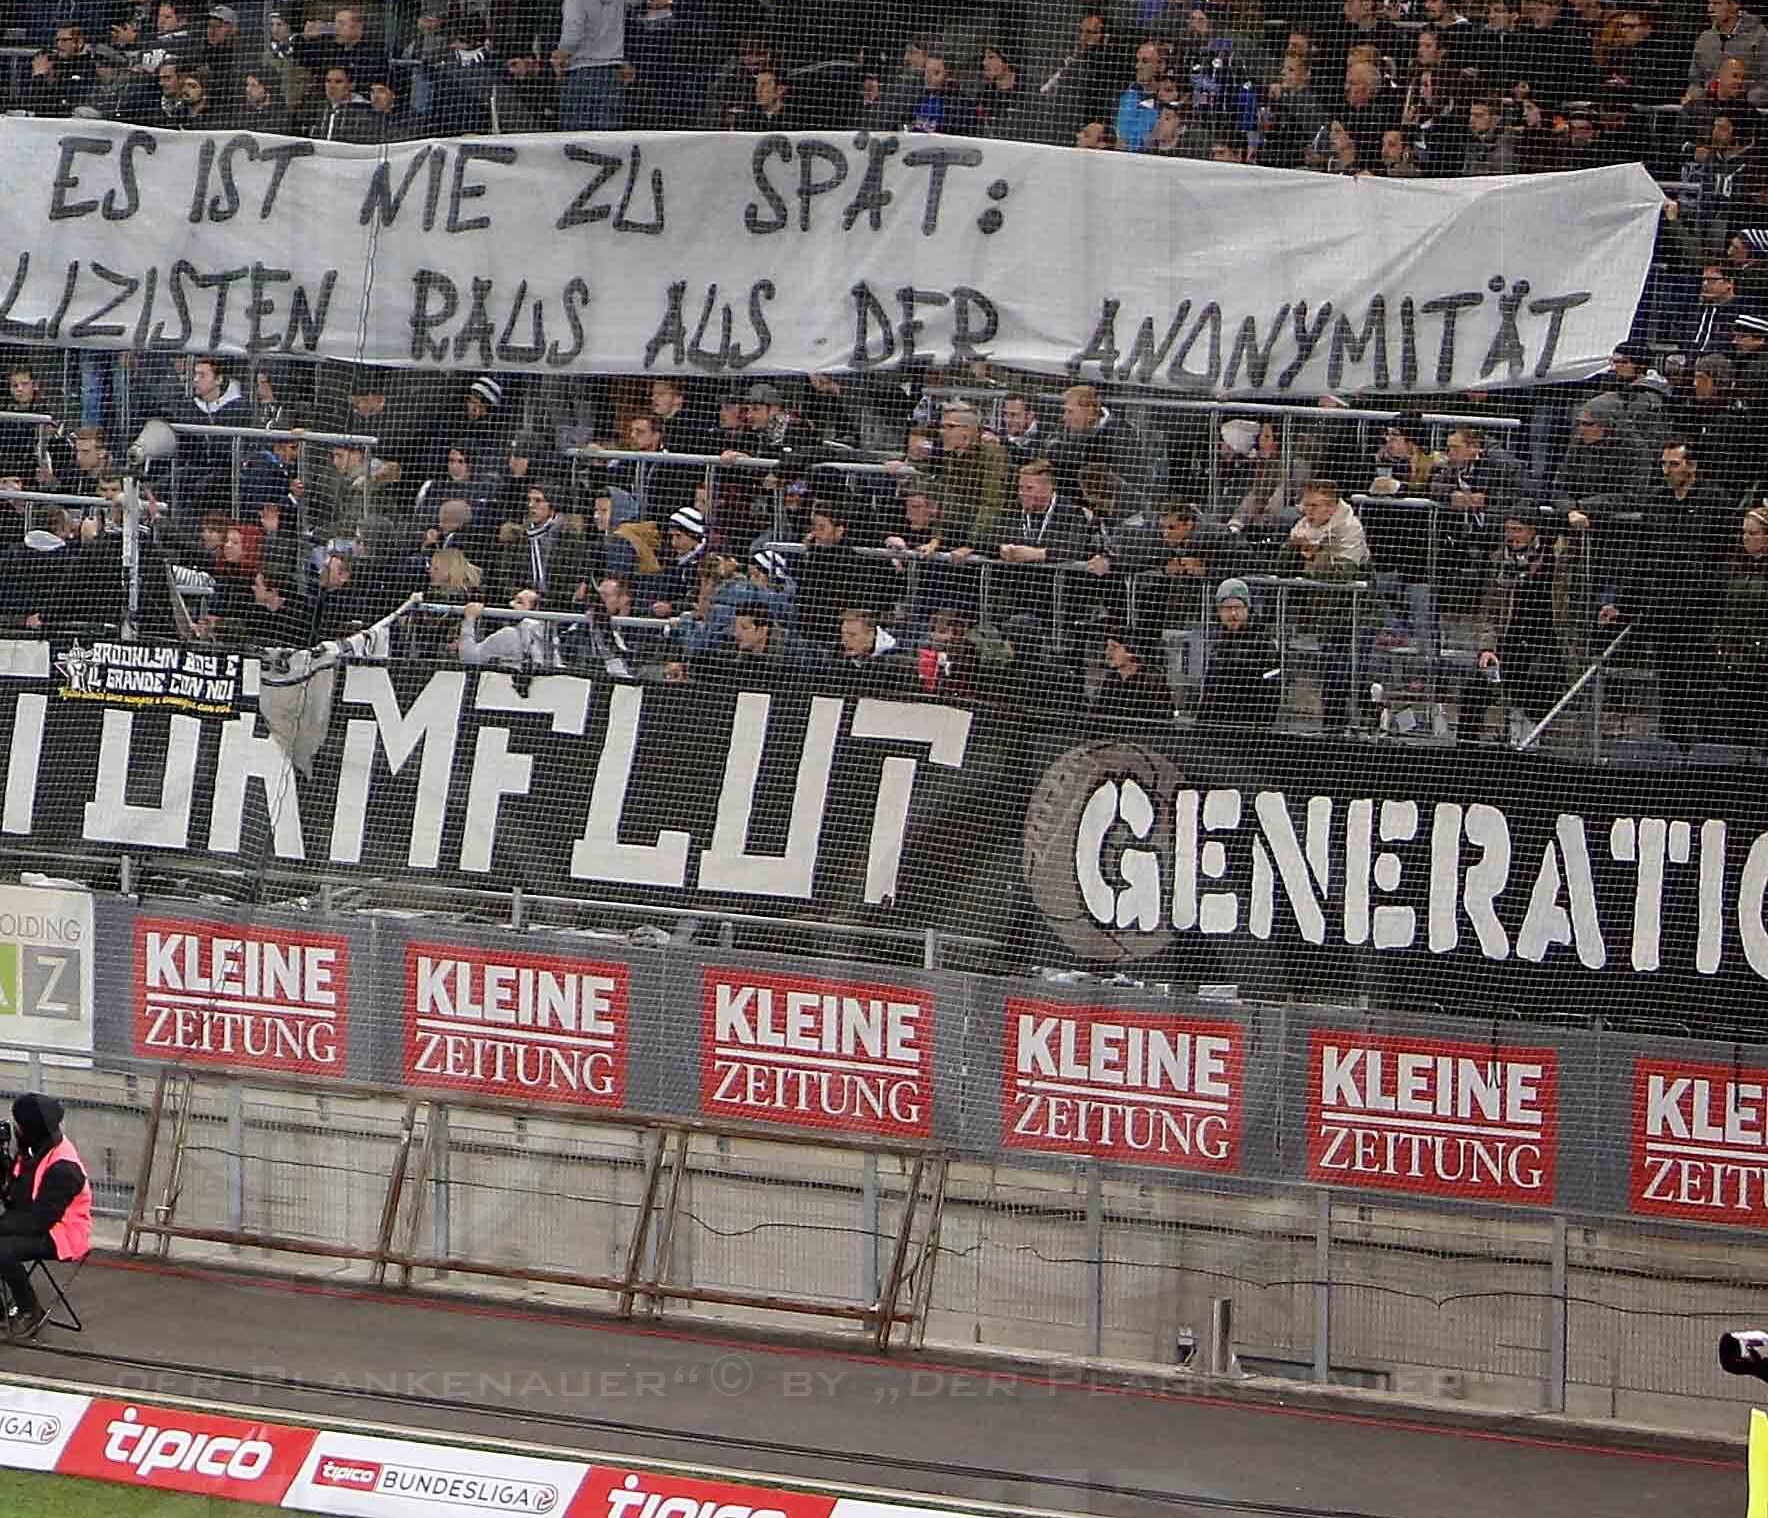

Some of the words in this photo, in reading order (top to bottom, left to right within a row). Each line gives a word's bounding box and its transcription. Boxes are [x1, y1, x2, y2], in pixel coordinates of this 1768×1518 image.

[50, 129, 155, 223] ES
[190, 134, 315, 225] IST
[361, 144, 516, 233] NIE
[557, 142, 665, 238] ZU
[744, 129, 1010, 236] SPÄT:
[409, 267, 590, 370] RAUS
[644, 279, 776, 373] AUS
[849, 283, 1000, 368] DER
[1067, 275, 1593, 396] ANONYMITÄT
[144, 932, 337, 1005] KLEINE
[416, 955, 617, 1036] KLEINE
[143, 1005, 338, 1063] ZEITUNG
[713, 984, 923, 1064] KLEINE
[1016, 1015, 1231, 1098] KLEINE
[414, 1031, 617, 1096] ZEITUNG
[712, 1060, 922, 1125] ZEITUNG
[1320, 1044, 1543, 1126] KLEINE
[1013, 1091, 1231, 1161] ZEITUNG
[1646, 1074, 1768, 1146] KLE
[1318, 1125, 1544, 1190] ZEITUNG
[1642, 1155, 1768, 1211] ZEIT
[104, 1406, 274, 1483] tipico
[322, 1456, 378, 1490] tipico
[381, 1465, 530, 1512] BUNDESLIGA
